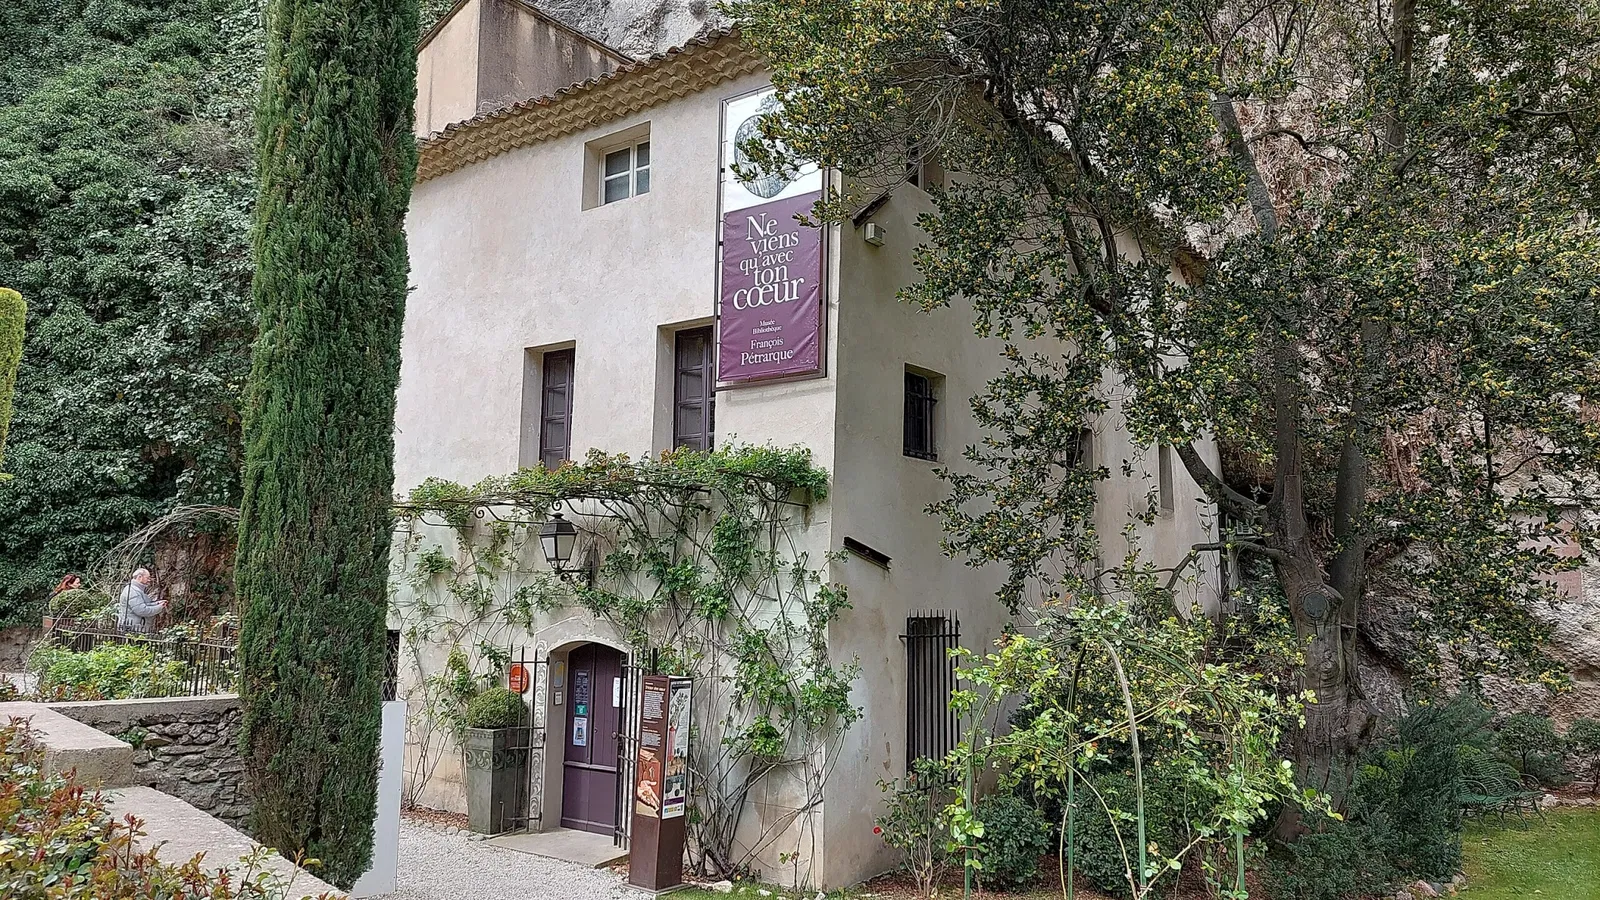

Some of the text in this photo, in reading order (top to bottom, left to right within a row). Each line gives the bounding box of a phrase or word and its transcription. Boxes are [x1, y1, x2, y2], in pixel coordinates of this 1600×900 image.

[751, 230, 799, 255] viens
[740, 249, 794, 275] qu'avec
[753, 265, 789, 286] ton
[733, 276, 804, 310] cœur
[752, 326, 783, 335] Bibliothèque
[759, 319, 775, 327] Musée
[750, 337, 783, 349] François
[740, 349, 794, 365] Pétrarque
